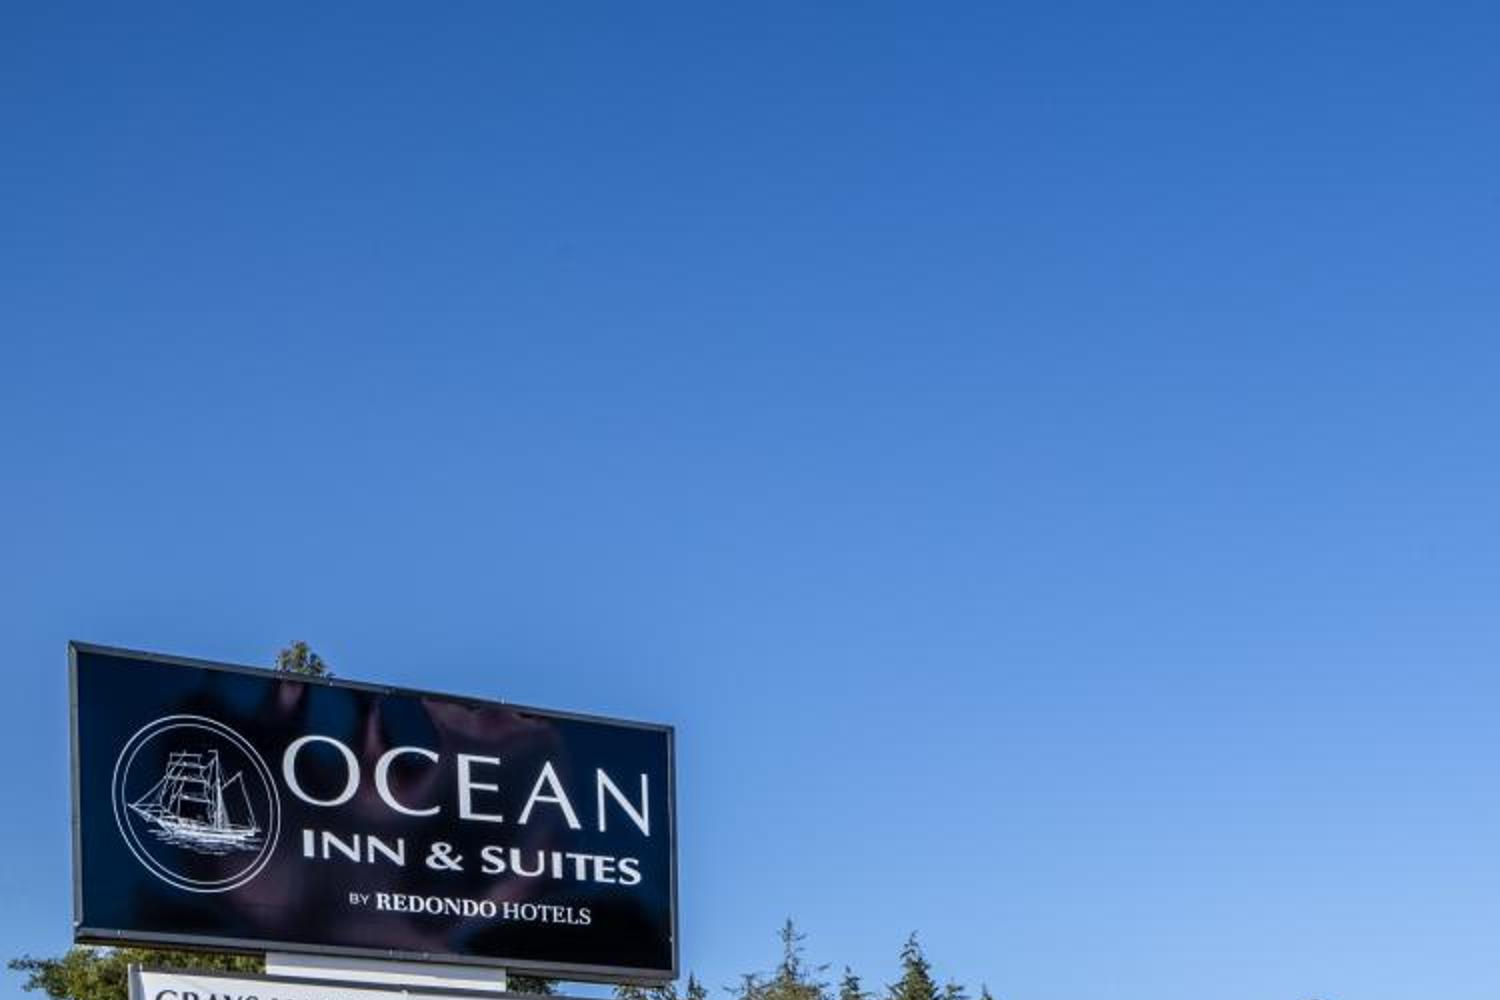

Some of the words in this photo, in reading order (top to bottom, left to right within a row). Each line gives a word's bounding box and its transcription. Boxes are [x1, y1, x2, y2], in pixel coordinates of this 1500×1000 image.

[282, 735, 651, 837] OCEAN
[302, 829, 406, 867] INN
[425, 842, 465, 872] &
[480, 845, 642, 886] SUITES
[349, 892, 369, 905] BY
[376, 892, 497, 918] REDONDO
[502, 901, 592, 926] HOTELS
